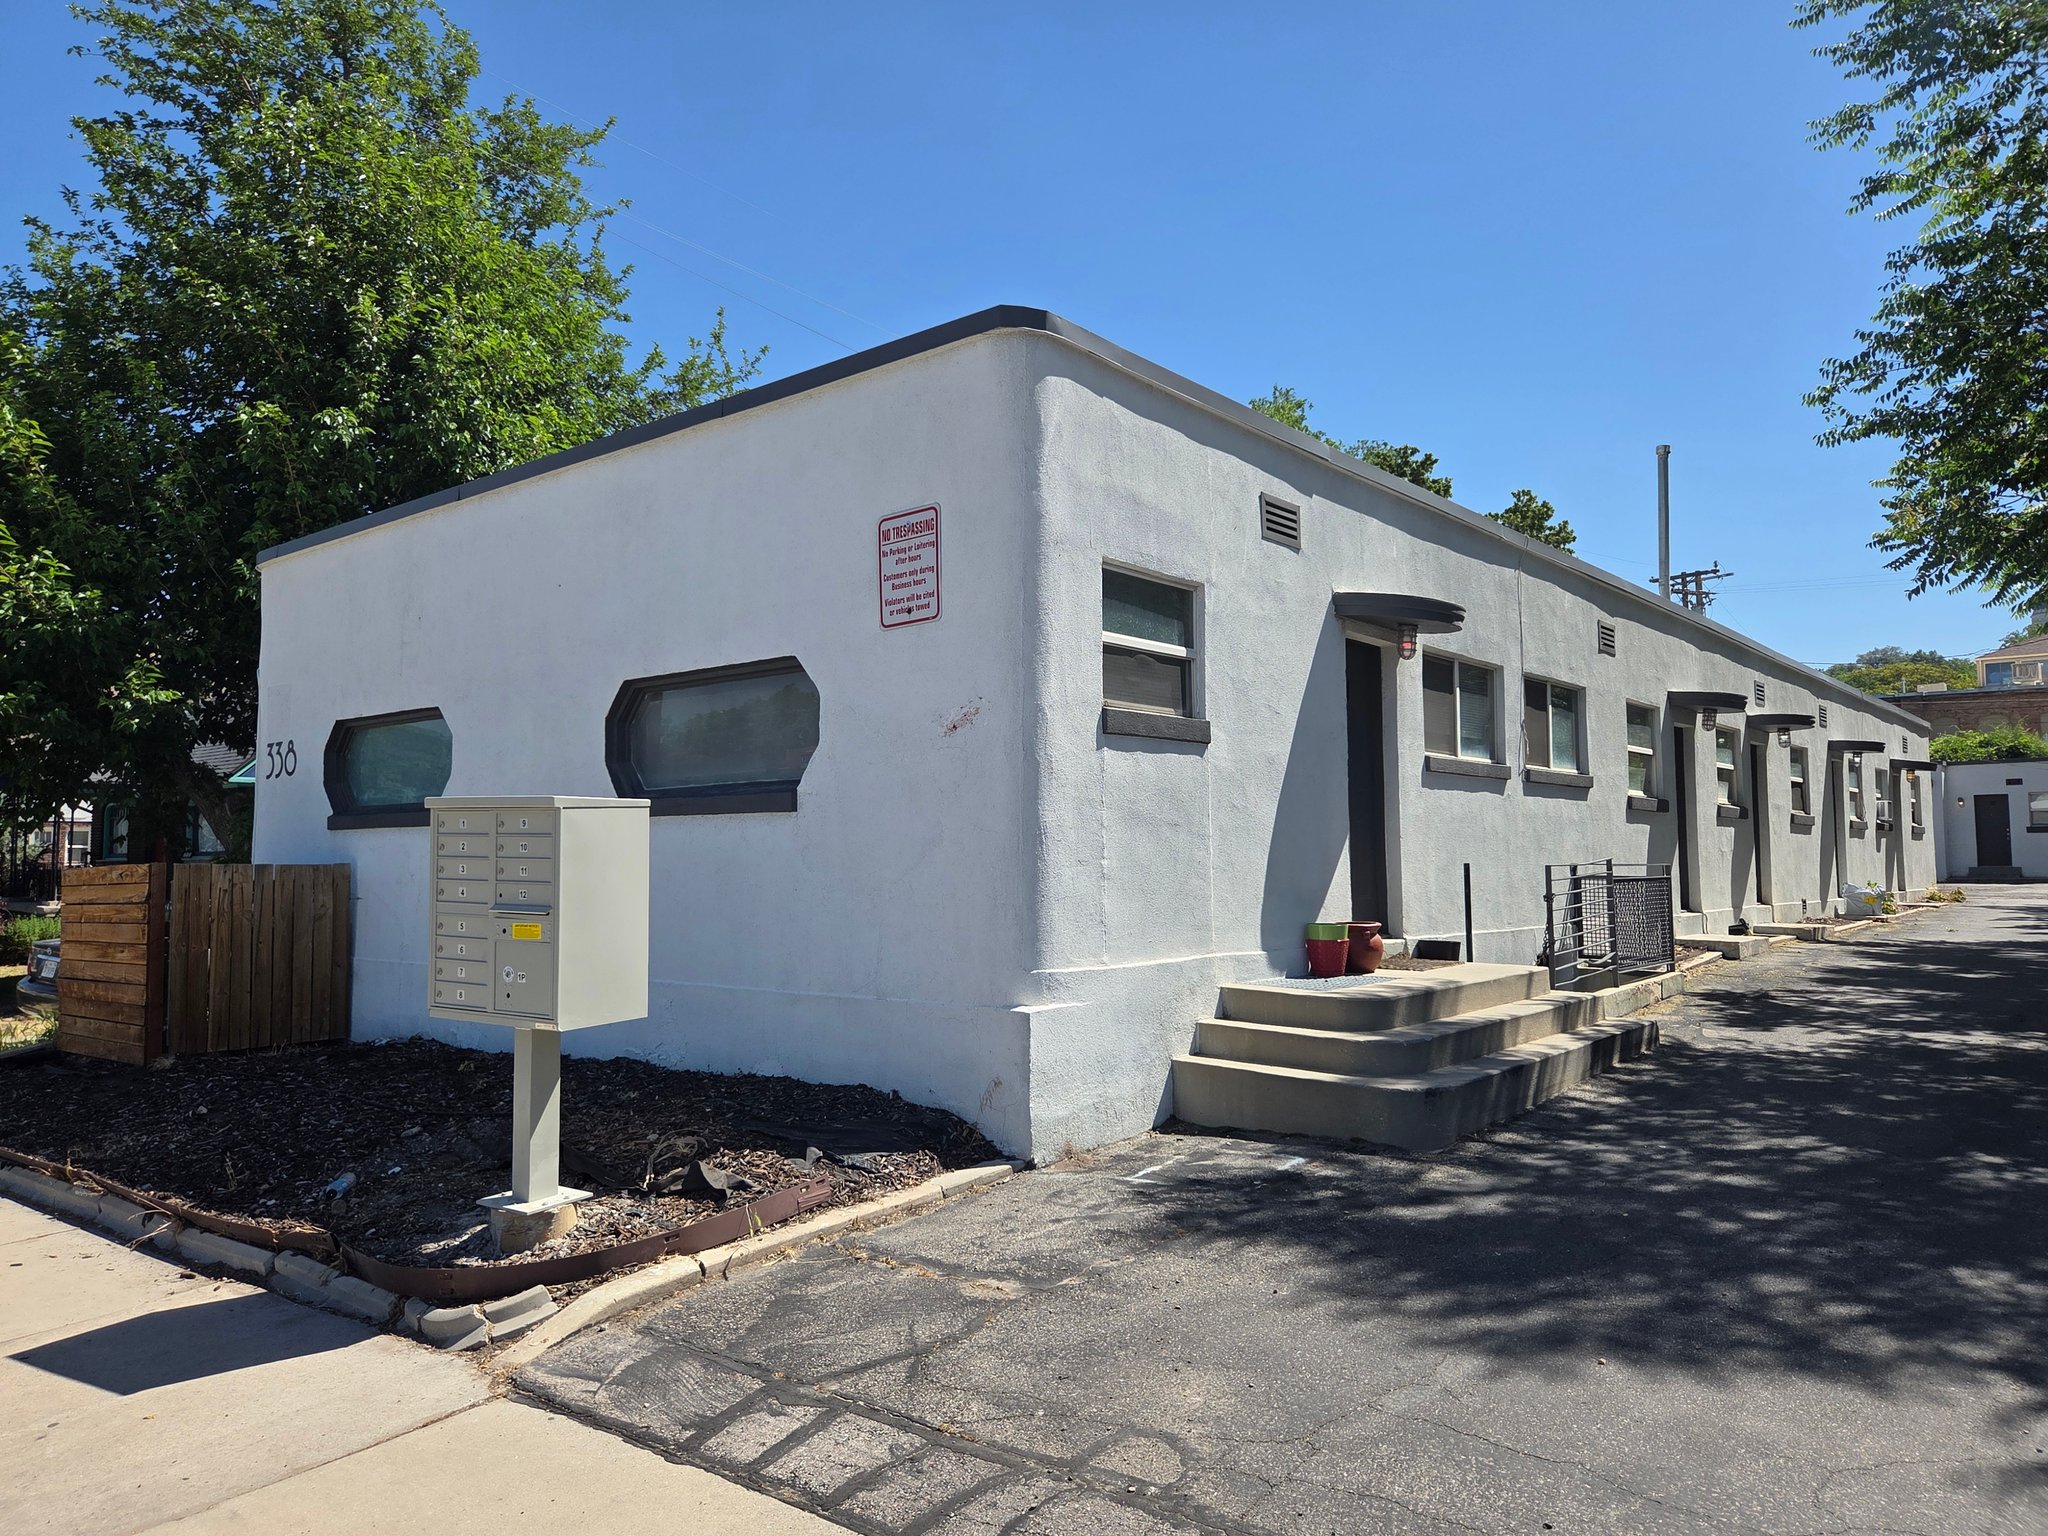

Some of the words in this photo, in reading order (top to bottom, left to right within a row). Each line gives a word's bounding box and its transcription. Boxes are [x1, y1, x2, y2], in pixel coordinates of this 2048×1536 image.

[882, 528, 891, 542] NO
[892, 518, 934, 540] TRESPASSING
[889, 546, 907, 556] Parking
[914, 539, 935, 551] Loitering
[895, 556, 907, 565] after
[908, 554, 921, 563] hours
[883, 571, 908, 582] Customers
[908, 568, 918, 577] only
[919, 565, 935, 574] during
[891, 581, 912, 591] Business
[912, 578, 926, 586] hours
[884, 597, 905, 607] Violators
[906, 593, 915, 602] will
[923, 589, 935, 599] cited
[915, 601, 930, 611] towed
[265, 739, 297, 780] 338
[520, 842, 528, 852] 10
[520, 866, 528, 876] 11
[520, 890, 528, 900] 12
[518, 972, 526, 982] 1P
